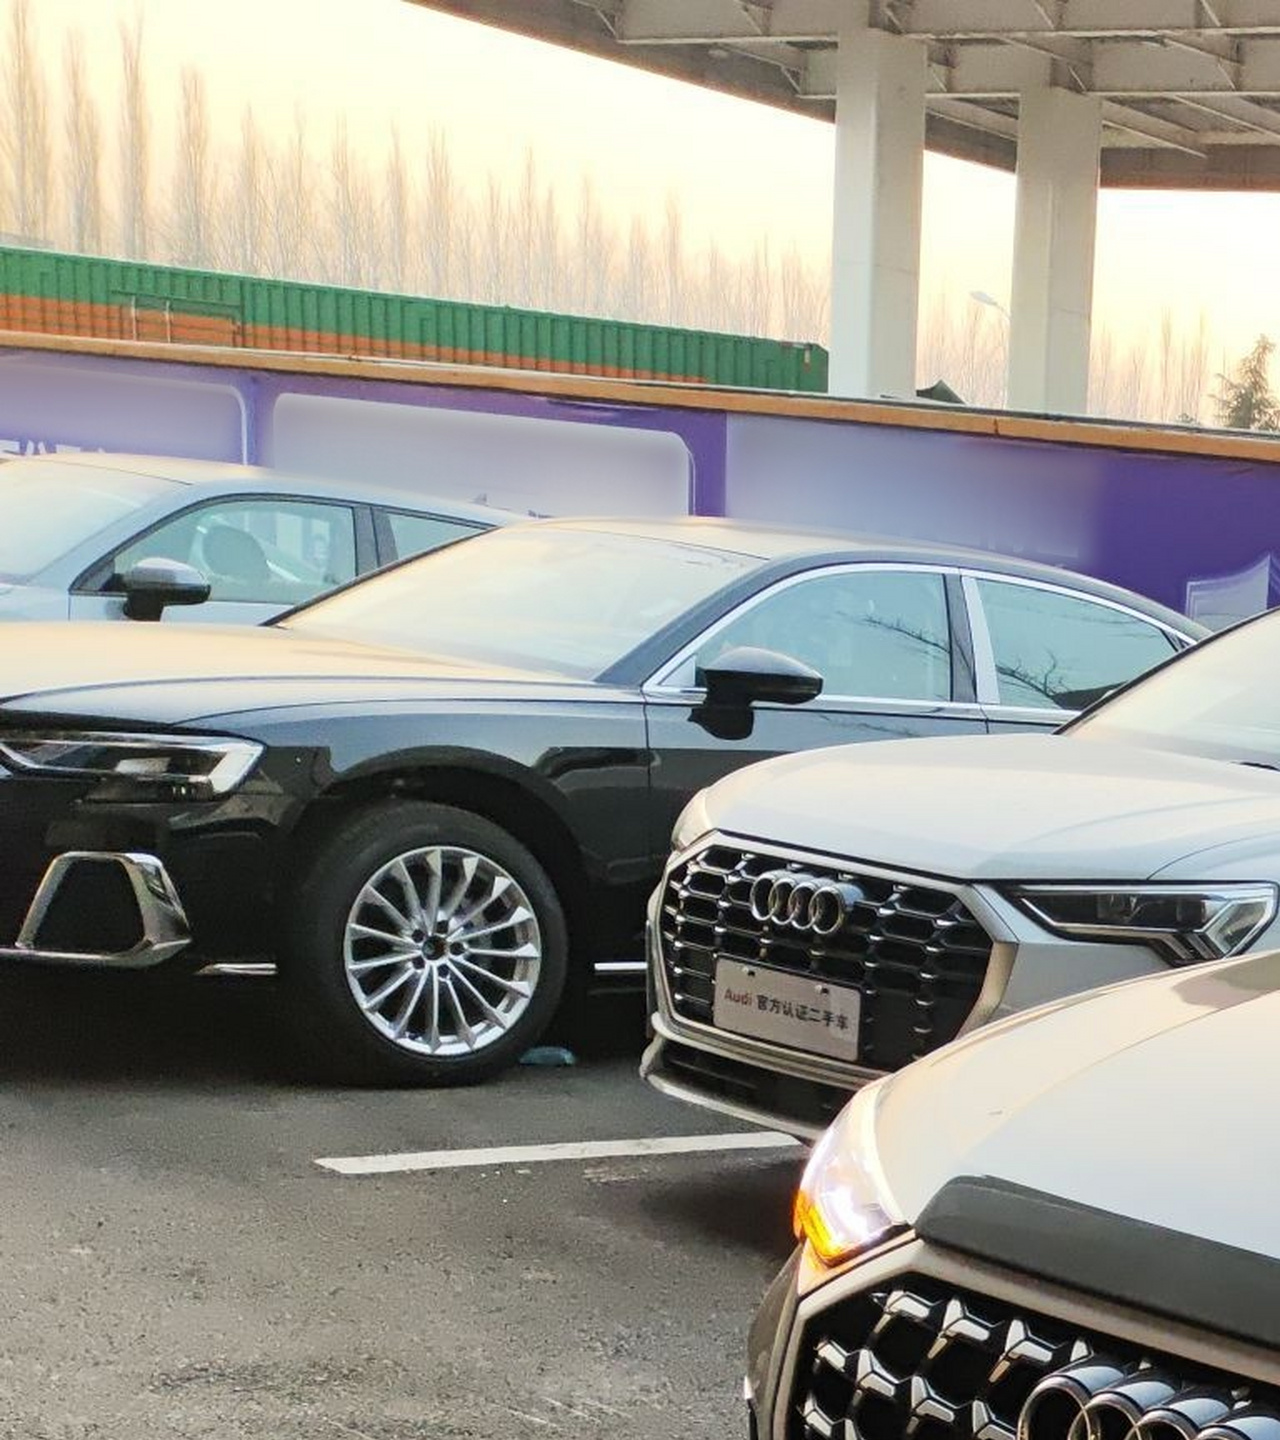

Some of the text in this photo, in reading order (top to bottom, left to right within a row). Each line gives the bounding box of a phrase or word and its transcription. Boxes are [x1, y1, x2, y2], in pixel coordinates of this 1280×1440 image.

[724, 988, 849, 1030] Audi 官方认证二手车
